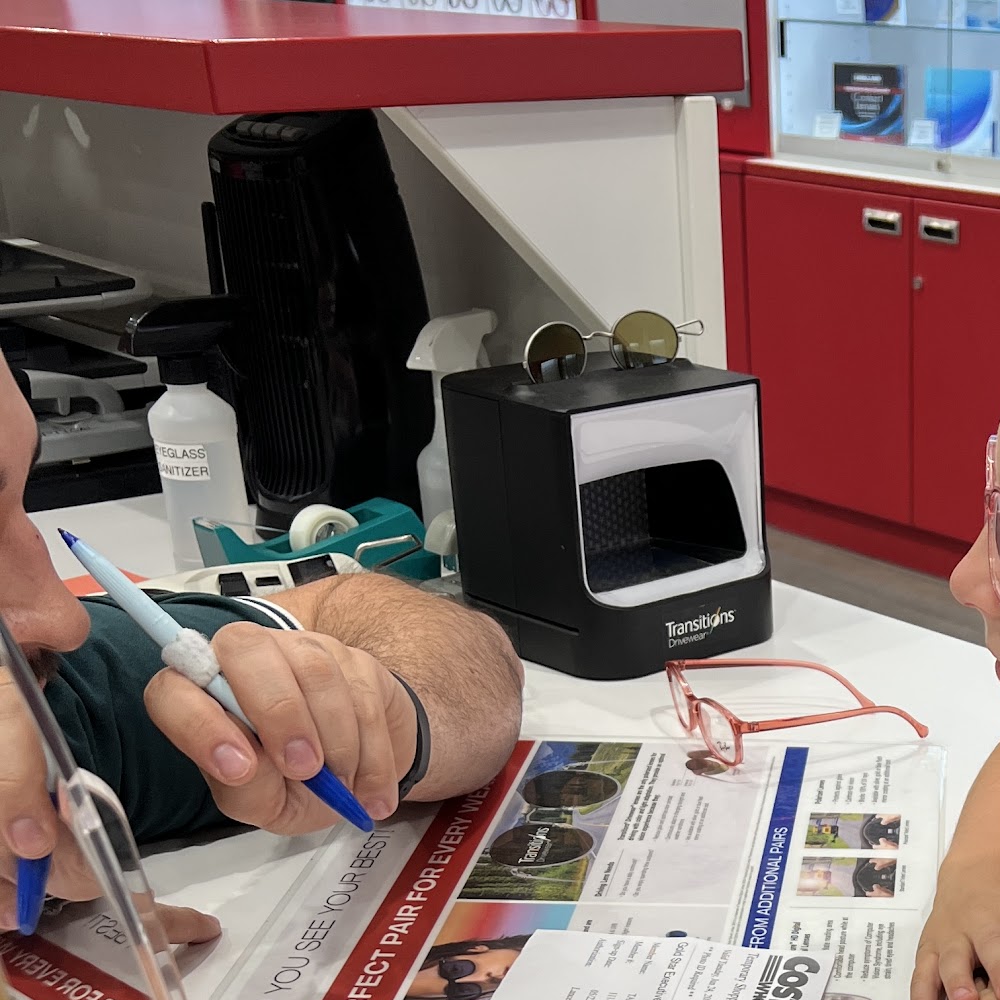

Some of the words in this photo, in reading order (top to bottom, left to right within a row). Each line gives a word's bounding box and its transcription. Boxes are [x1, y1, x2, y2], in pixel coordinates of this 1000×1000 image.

[665, 606, 737, 637] Transitions
[518, 826, 551, 864] Transitions
[380, 903, 423, 945] PAIR
[406, 866, 445, 903] FOR
[427, 816, 473, 868] EVERY
[756, 855, 782, 916] ADDITIONAL
[770, 826, 789, 854] PAIRS
[264, 956, 311, 995] YOU
[294, 919, 336, 952] SEE
[317, 872, 366, 915] YOUR
[350, 828, 396, 870] BEST!
[674, 942, 688, 956] Gold
[698, 951, 711, 965] Photo
[863, 945, 871, 962] symptoms
[667, 957, 682, 970] Star
[696, 964, 706, 972] ID
[735, 953, 760, 982] Temporary
[687, 970, 703, 990] Required
